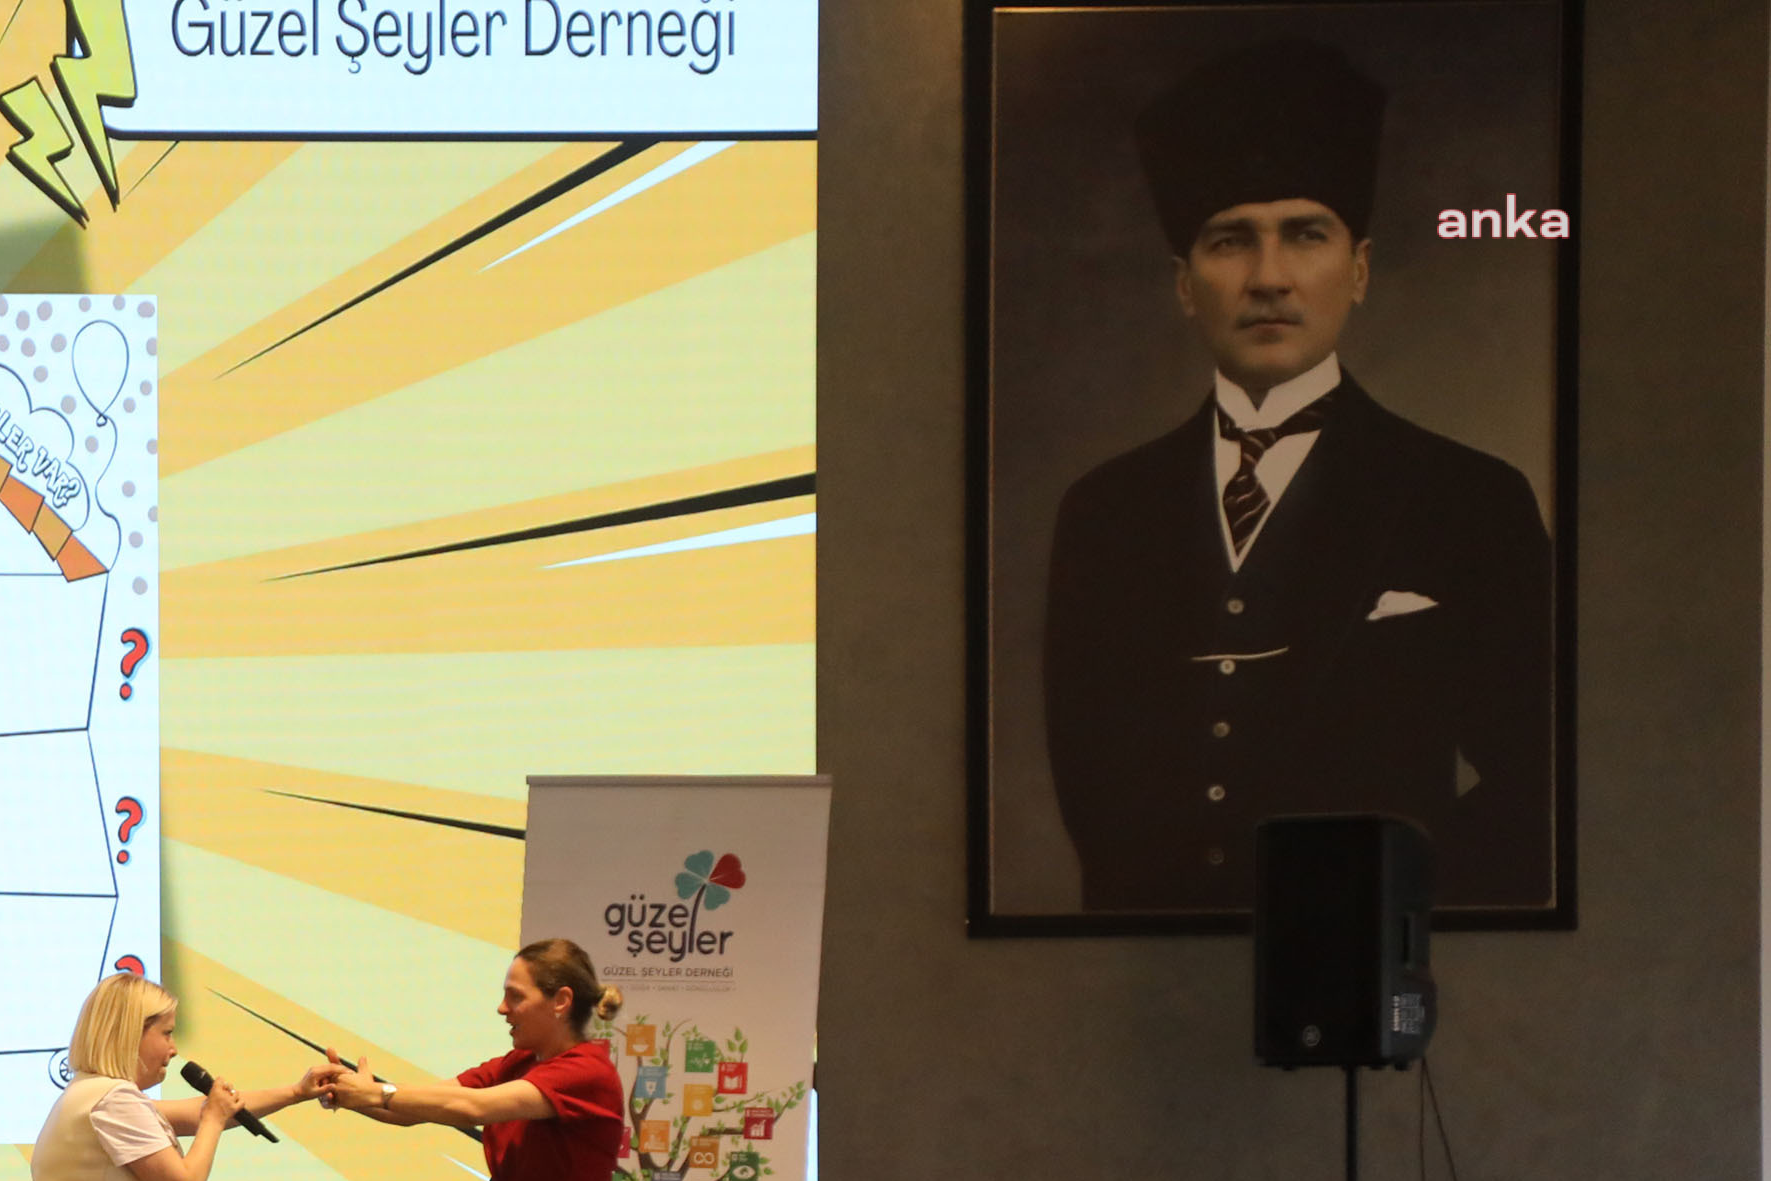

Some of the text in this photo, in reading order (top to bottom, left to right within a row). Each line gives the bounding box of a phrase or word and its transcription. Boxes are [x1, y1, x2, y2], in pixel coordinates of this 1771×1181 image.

[171, 0, 735, 75] Güzel Şeyler Derneği
[31, 446, 81, 510] VAR?
[605, 886, 706, 935] güzel
[627, 930, 734, 962] şeyler
[603, 966, 734, 977] GÜZEL ŞEYLER DERNEĞİ
